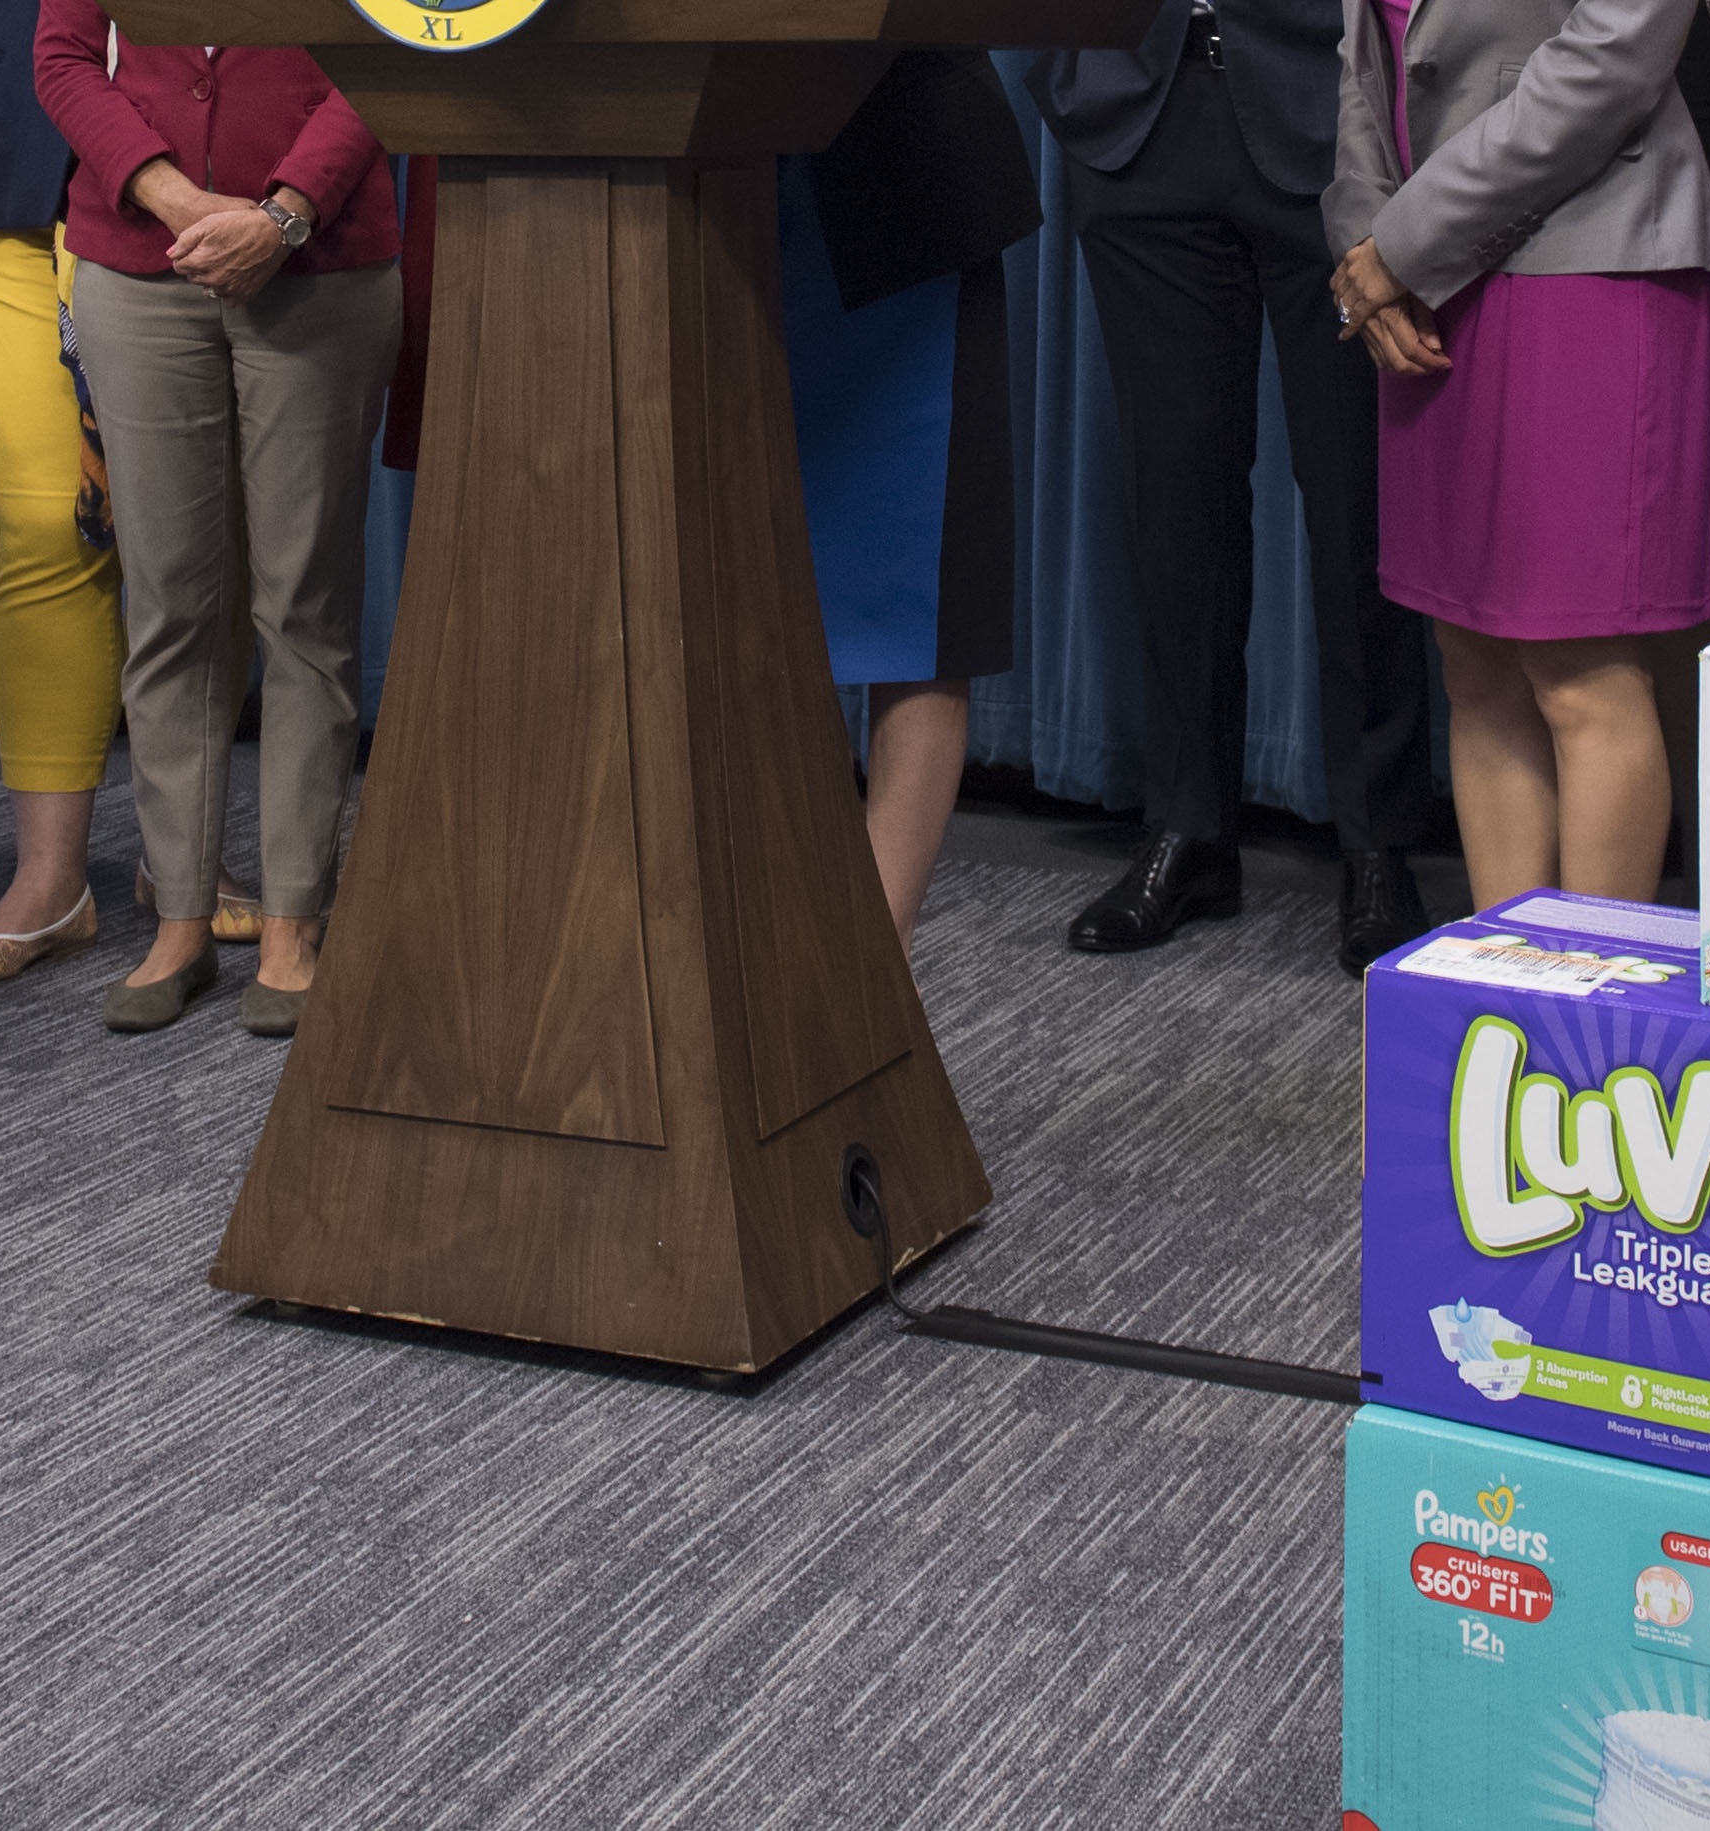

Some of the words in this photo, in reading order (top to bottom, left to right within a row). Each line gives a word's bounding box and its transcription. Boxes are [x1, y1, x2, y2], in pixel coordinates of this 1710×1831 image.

[420, 16, 462, 41] XL
[1536, 1360, 1545, 1370] 3
[1546, 1361, 1609, 1385] Absorption
[1536, 1373, 1568, 1391] Areas
[1415, 1489, 1549, 1562] Pampers
[1447, 1556, 1519, 1584] cruisers
